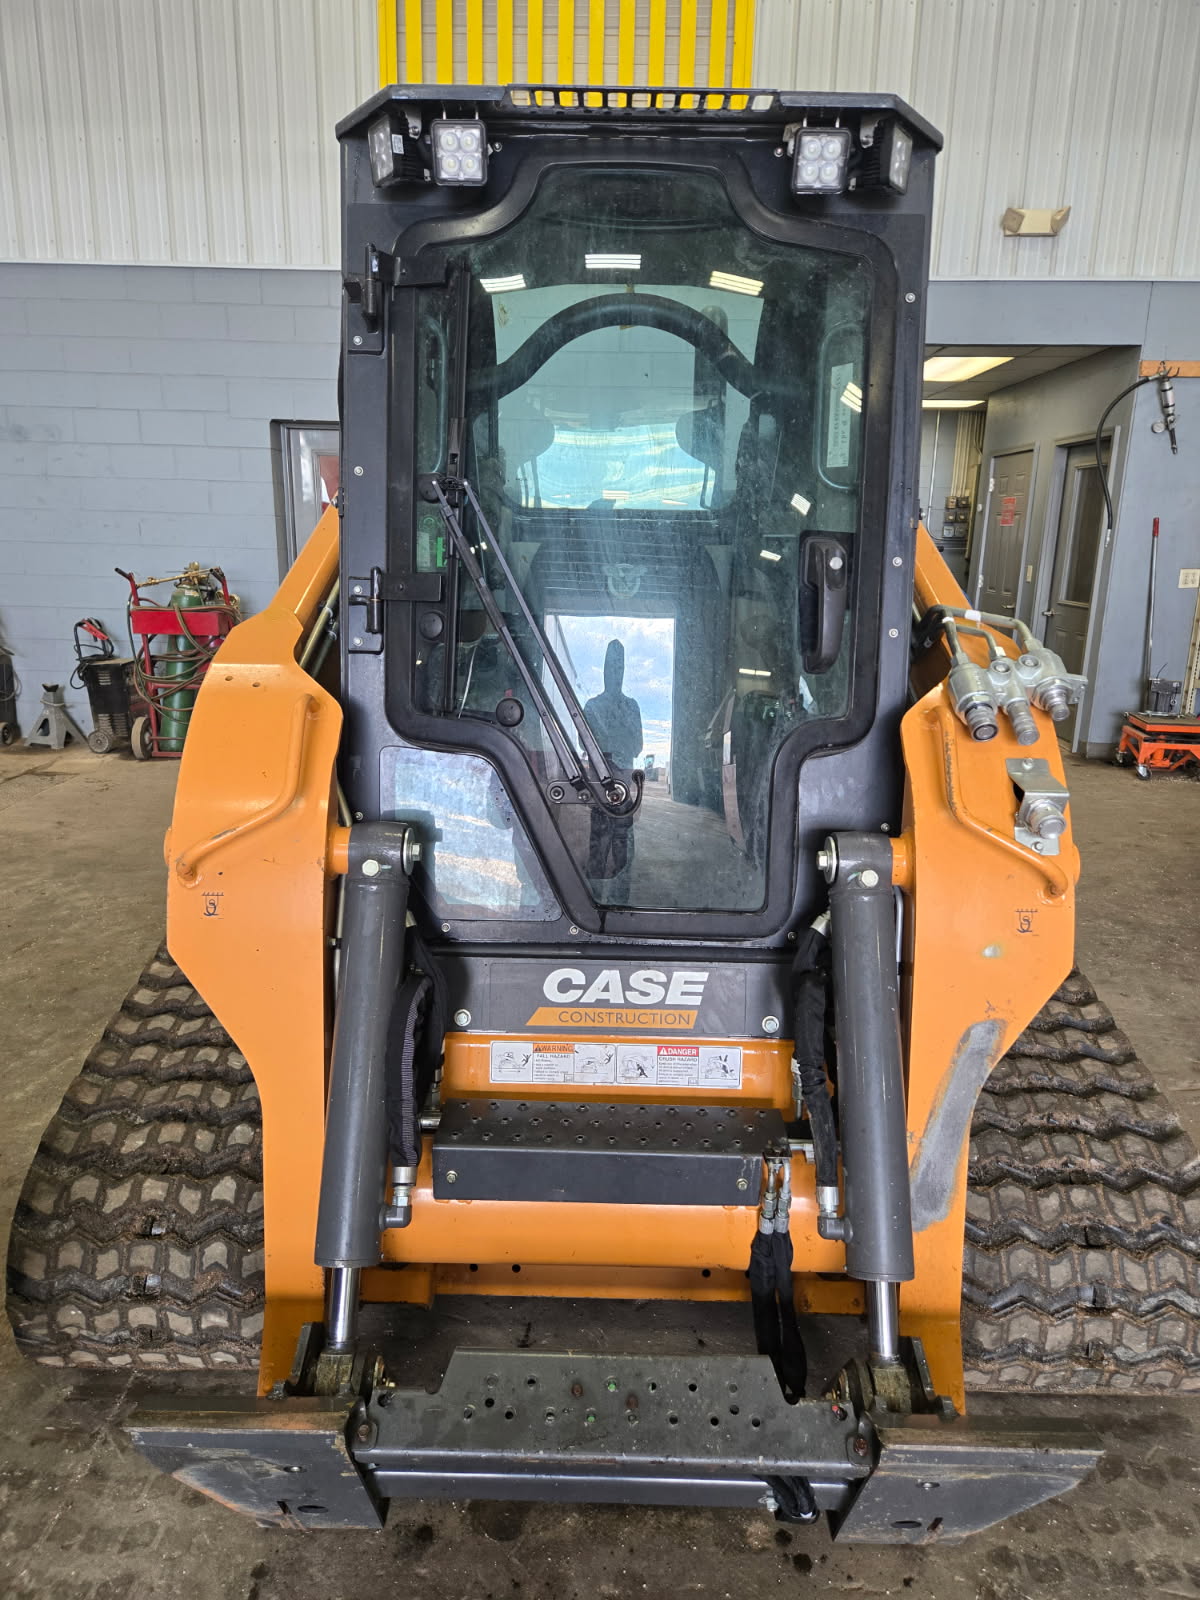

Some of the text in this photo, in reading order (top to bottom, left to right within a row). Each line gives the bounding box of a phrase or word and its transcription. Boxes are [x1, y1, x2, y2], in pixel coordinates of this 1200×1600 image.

[543, 968, 709, 1005] CASE
[558, 1010, 690, 1025] CONSTRUCTION
[541, 1044, 574, 1052] WARNING
[667, 1047, 697, 1055] DANGER
